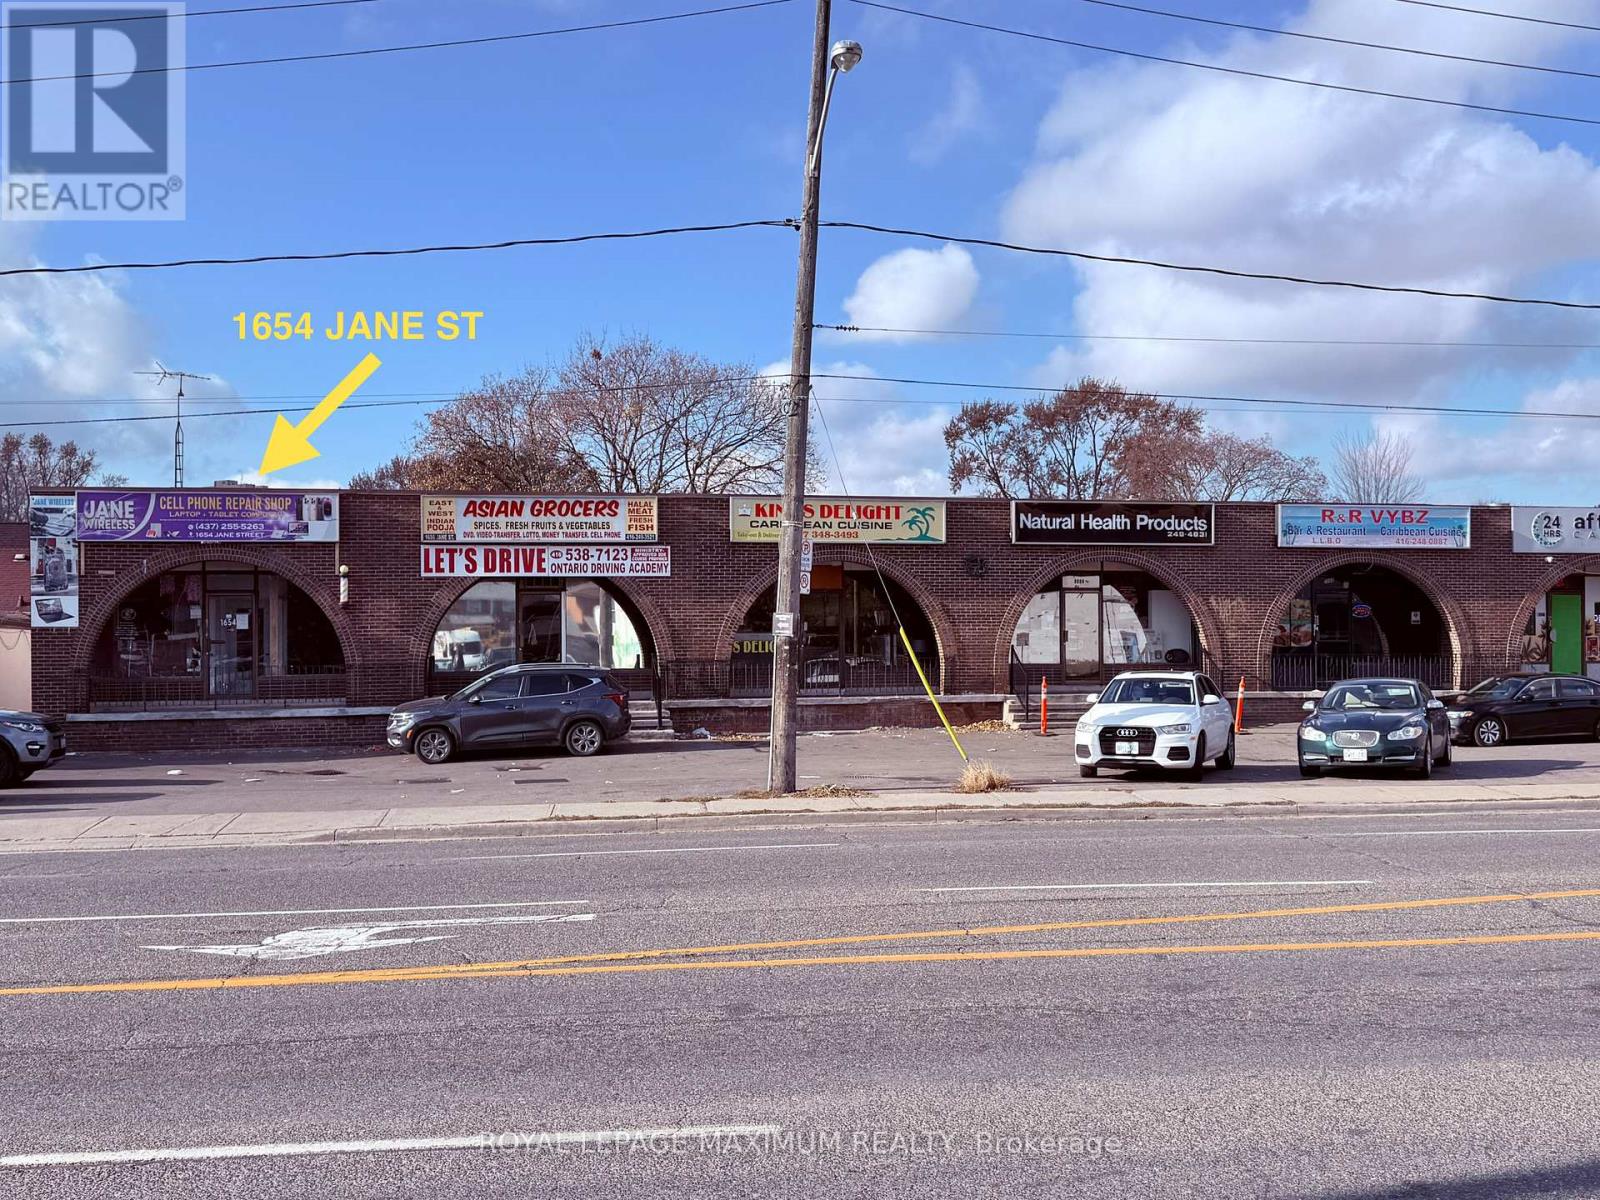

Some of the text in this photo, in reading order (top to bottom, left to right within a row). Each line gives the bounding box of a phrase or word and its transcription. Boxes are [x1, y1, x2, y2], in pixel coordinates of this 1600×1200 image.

[83, 500, 135, 519] JANE
[159, 497, 292, 511] CELL PHONE REPAIR SHOP
[462, 499, 620, 518] ASIAN GROCERS
[755, 503, 904, 520] KINS DELIGHT
[1369, 509, 1429, 524] VYBZ
[83, 519, 136, 530] WIRELESS
[195, 523, 219, 531] (437)
[426, 523, 455, 532] POOJA
[505, 521, 529, 530] FRESH
[531, 521, 557, 530] FRUITS
[558, 521, 564, 530] &
[565, 521, 611, 530] VEGETABLES
[750, 520, 893, 530] CARIEAN CUISINE
[1019, 513, 1208, 531] Natural Health Products
[1543, 515, 1560, 529] 24
[235, 531, 265, 539] STREET
[811, 530, 859, 539] 348-3493
[1287, 526, 1462, 537] Bar & Restaurant Caribbean Cuisine
[1543, 530, 1561, 538] HRS
[423, 547, 547, 574] LET'S DRIVE
[565, 548, 629, 562] 538-7123
[550, 563, 669, 574] ONTARIO DRIVING ACADEMY
[220, 618, 236, 626] 1654
